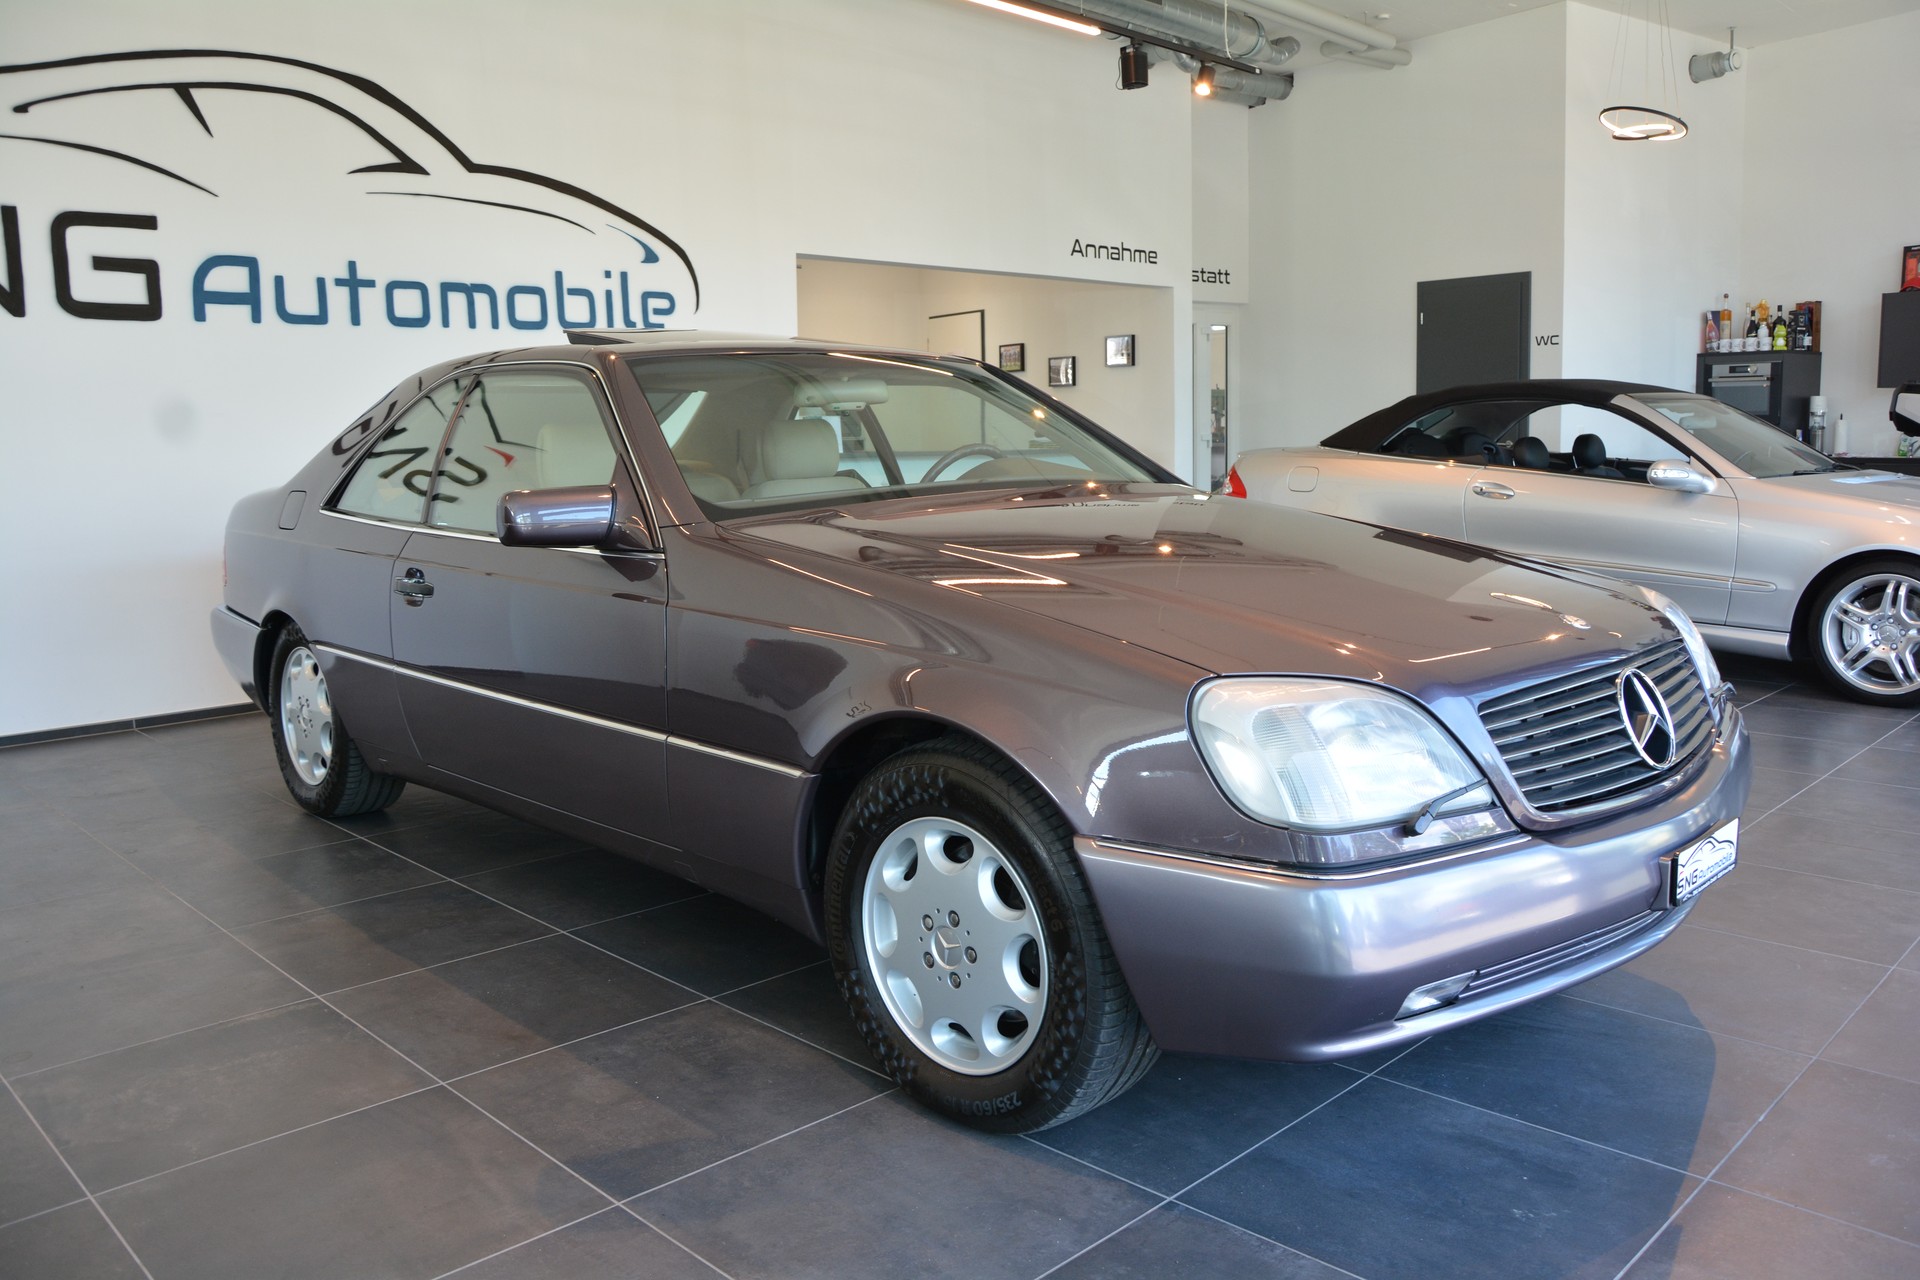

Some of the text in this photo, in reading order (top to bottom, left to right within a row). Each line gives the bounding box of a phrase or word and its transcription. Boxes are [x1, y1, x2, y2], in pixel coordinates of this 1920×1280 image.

[1070, 238, 1158, 264] Annahme
[1191, 268, 1231, 285] statt
[192, 254, 676, 331] Automobile
[1535, 334, 1560, 346] WC
[1677, 868, 1699, 895] SNG
[972, 1090, 1022, 1116] 235/60
